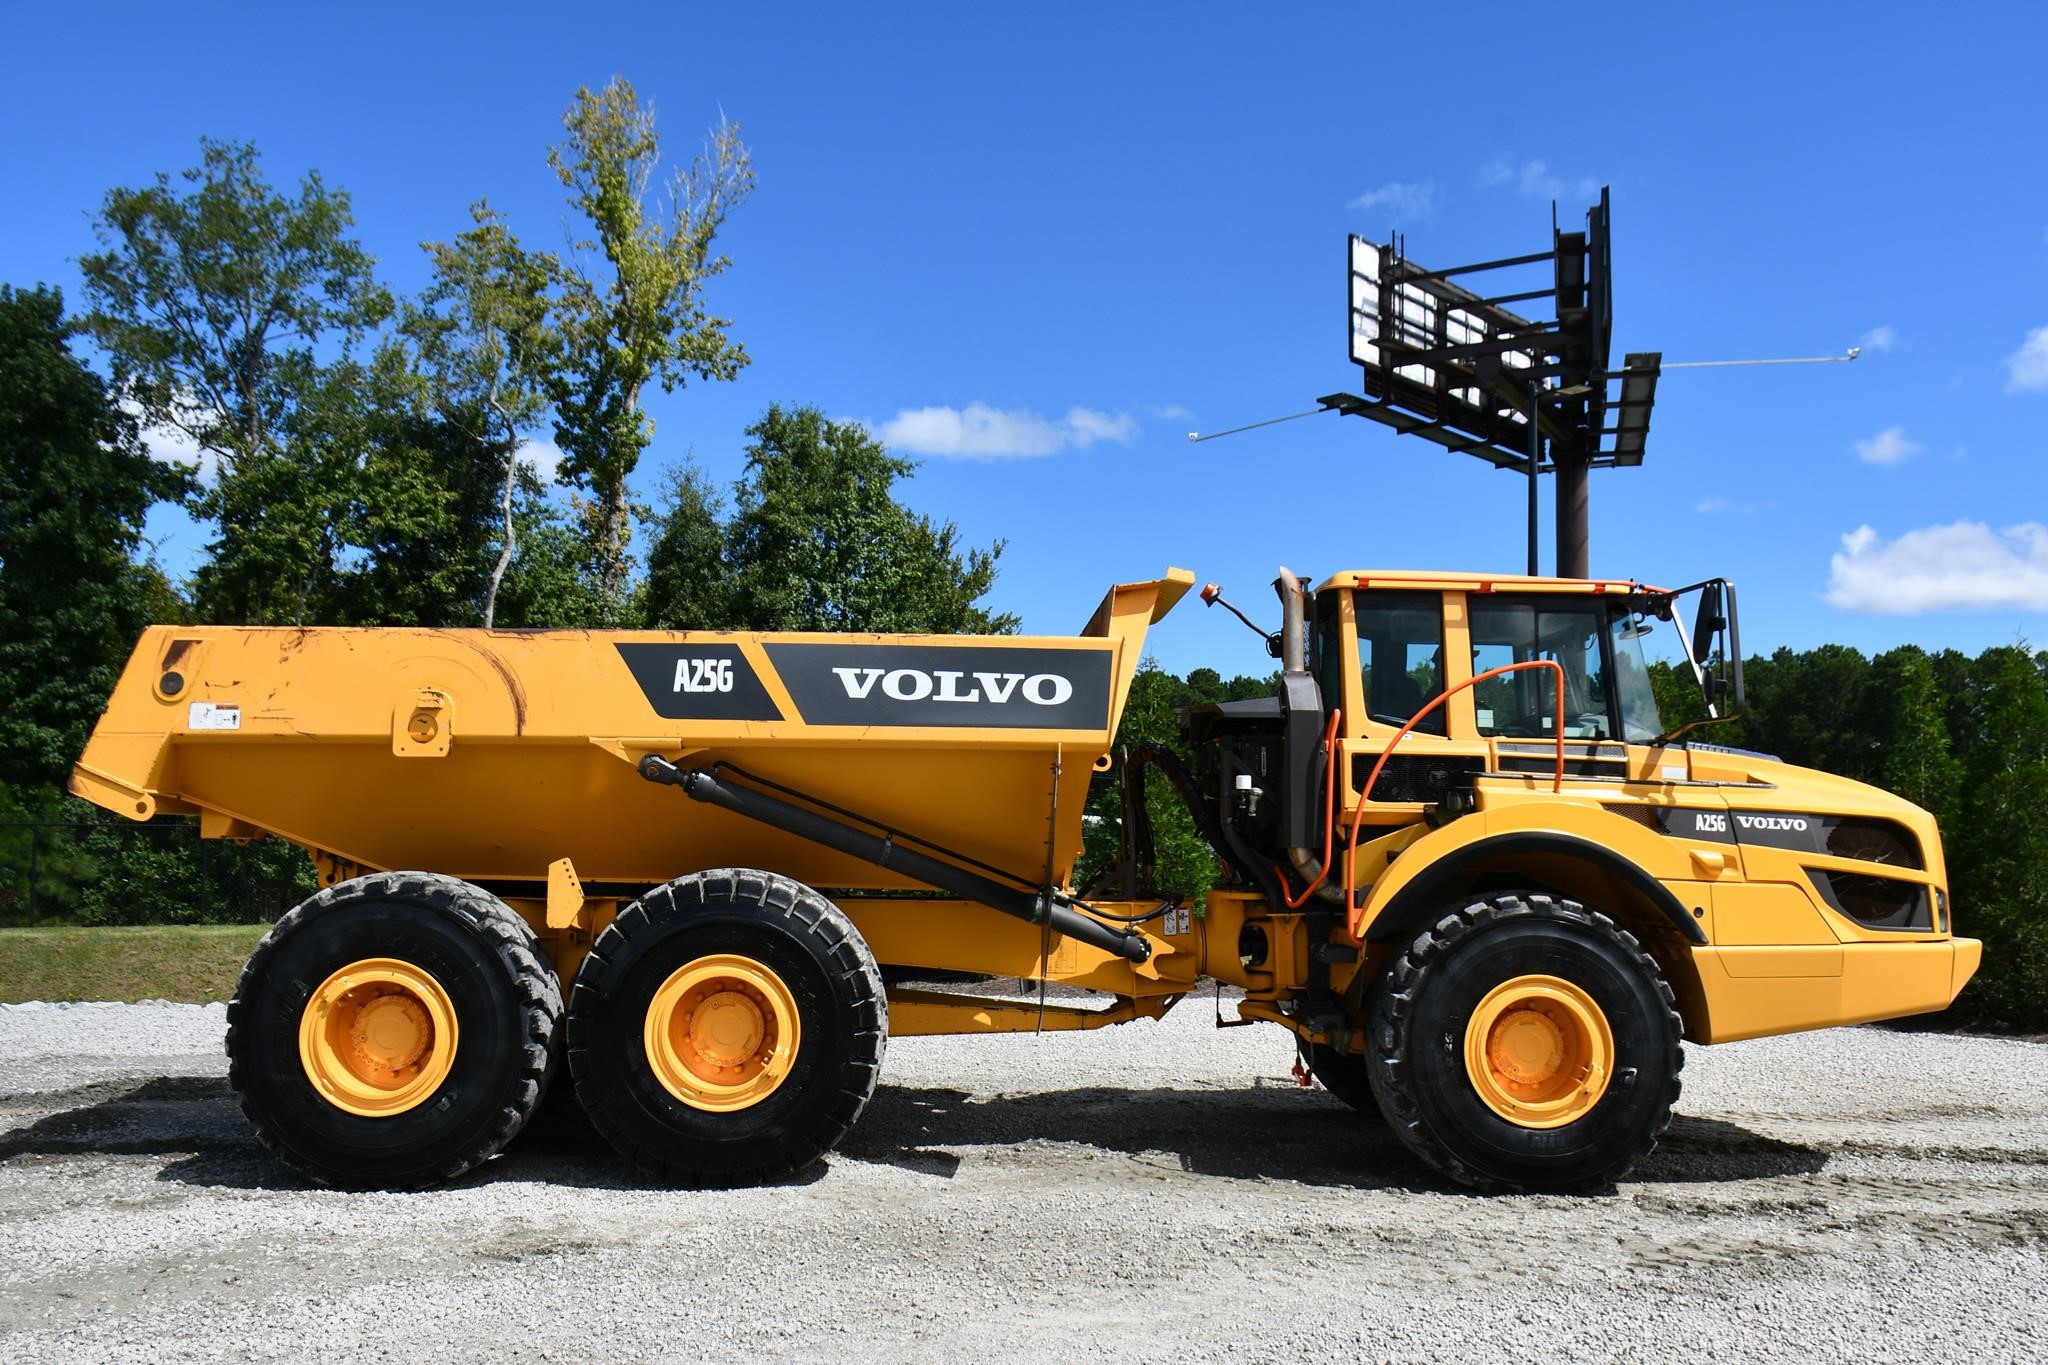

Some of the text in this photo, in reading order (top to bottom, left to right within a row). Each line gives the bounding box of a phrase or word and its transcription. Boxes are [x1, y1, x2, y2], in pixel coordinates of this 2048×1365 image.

[673, 659, 733, 693] A25G
[832, 667, 1073, 706] VOLVO
[1696, 814, 1726, 832] A25G
[1736, 815, 1808, 832] VOLVO
